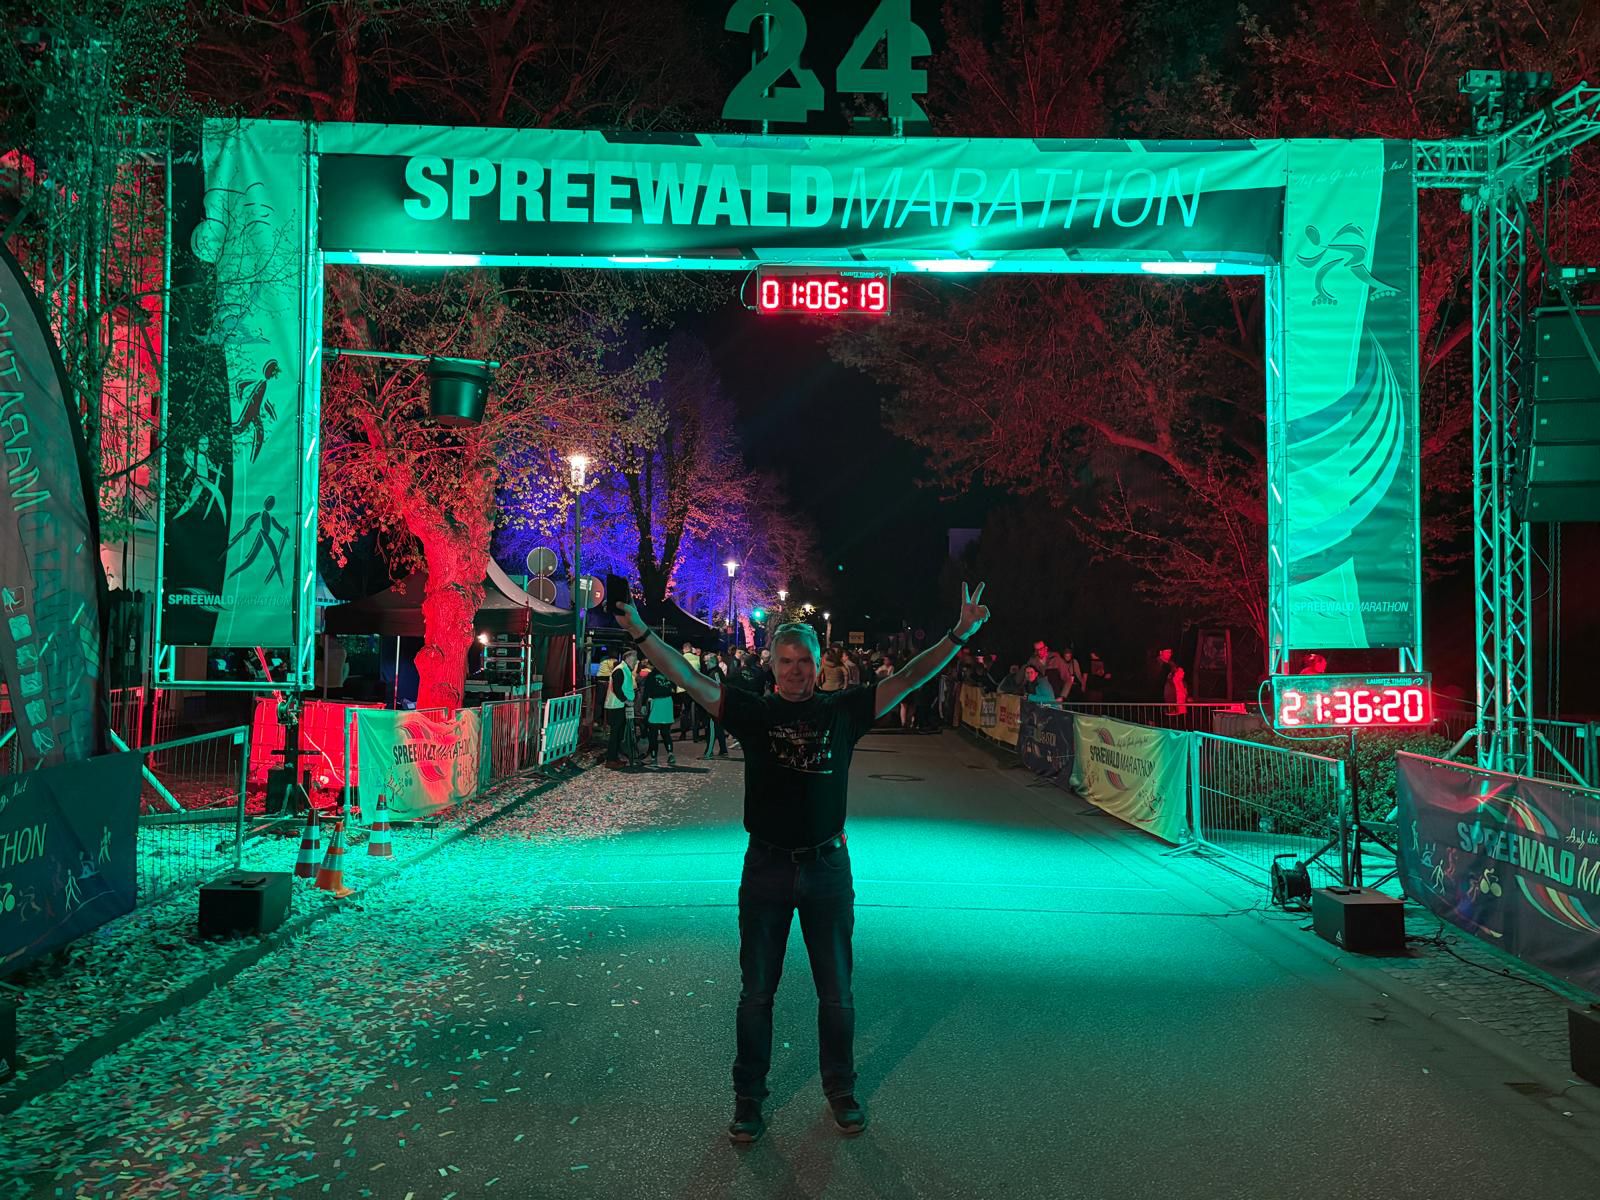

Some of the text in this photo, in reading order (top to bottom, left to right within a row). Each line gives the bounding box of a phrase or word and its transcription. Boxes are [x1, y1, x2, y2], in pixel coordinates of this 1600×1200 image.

[167, 594, 234, 606] SPREEWALD
[1294, 601, 1409, 612] SPREEWALD MARATHON
[1457, 821, 1575, 886] SPREEWALD
